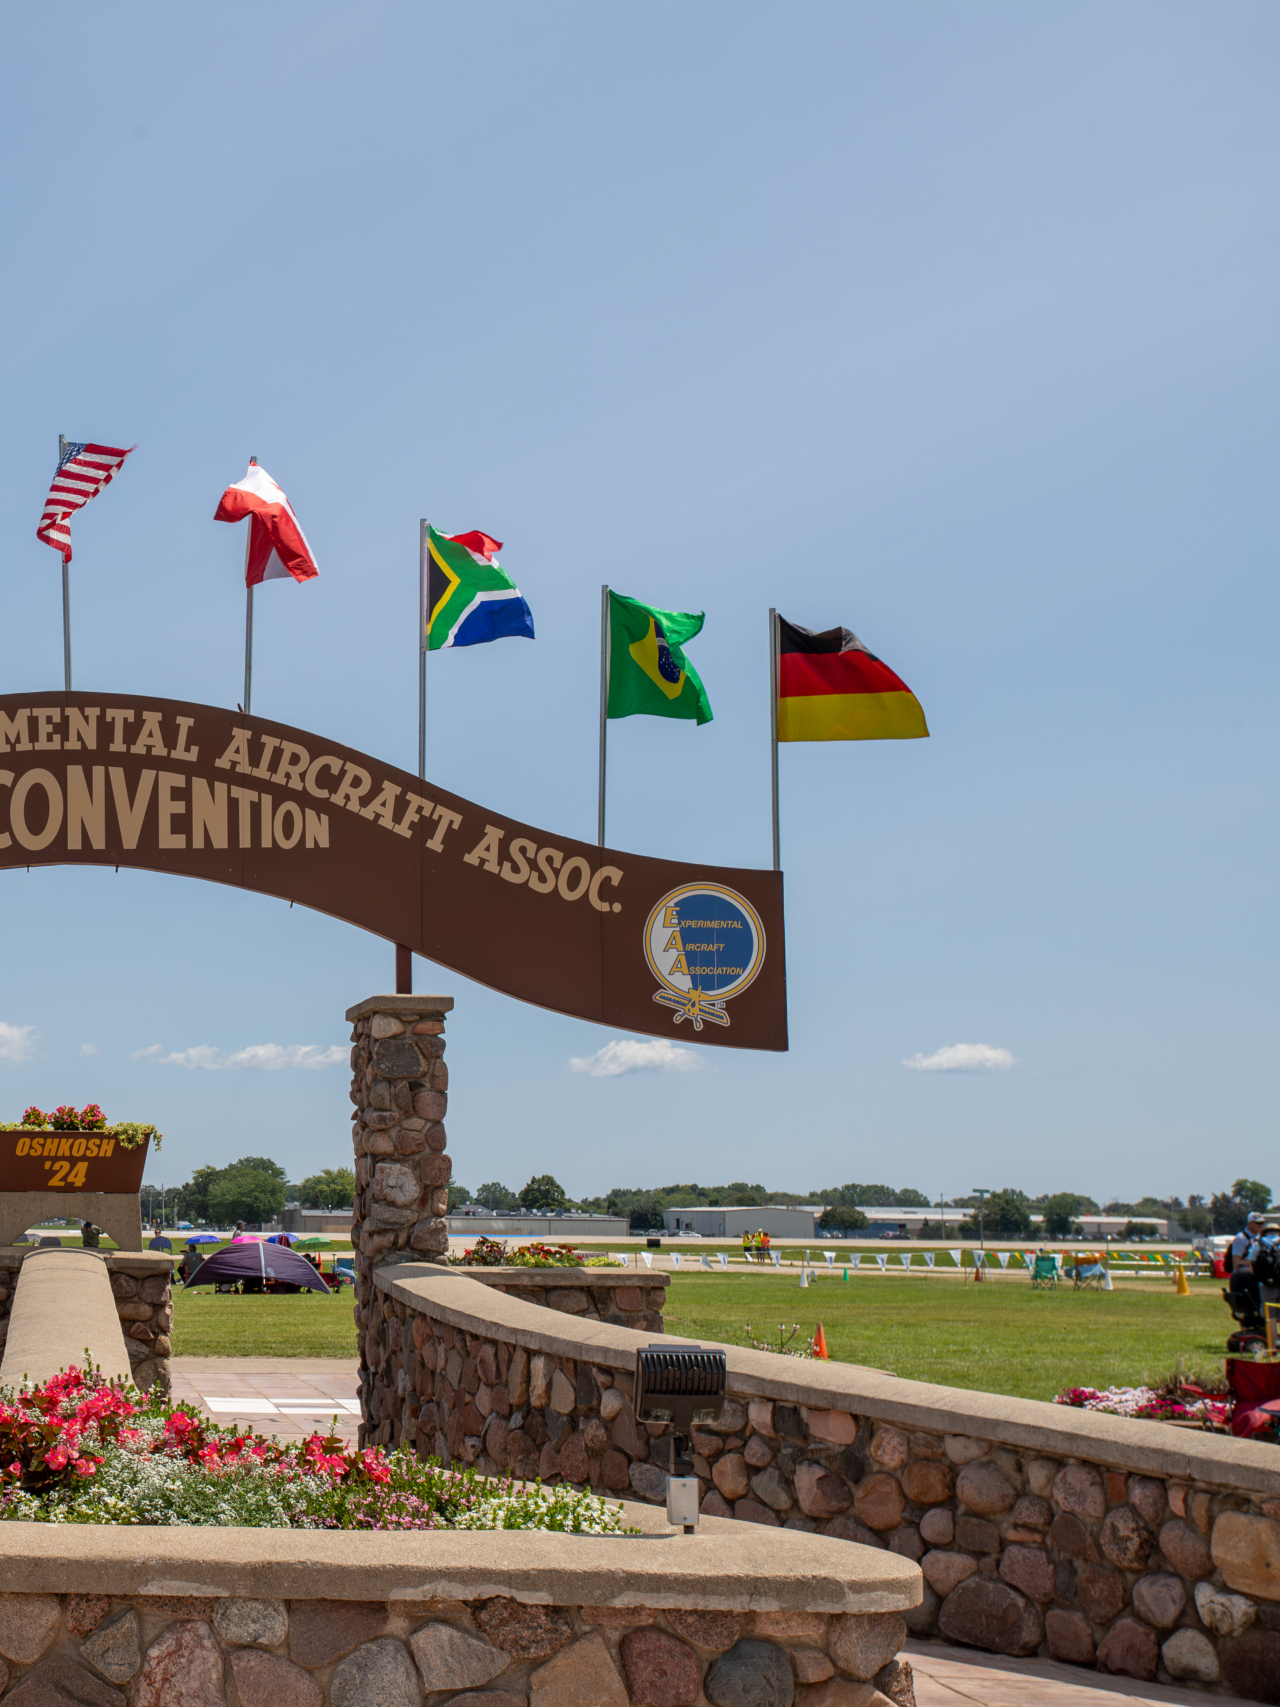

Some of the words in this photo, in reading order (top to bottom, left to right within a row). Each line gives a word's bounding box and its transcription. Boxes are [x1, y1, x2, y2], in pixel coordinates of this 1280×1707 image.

[214, 727, 463, 853] AIRCRAFT
[463, 824, 624, 913] ASSOC.
[663, 906, 743, 928] EXPERIMENTAL
[663, 930, 725, 952] AIRCRAFT
[668, 954, 743, 976] ASSOCIATION
[15, 1137, 116, 1157] OSHKOSH
[44, 1161, 89, 1187] '24
